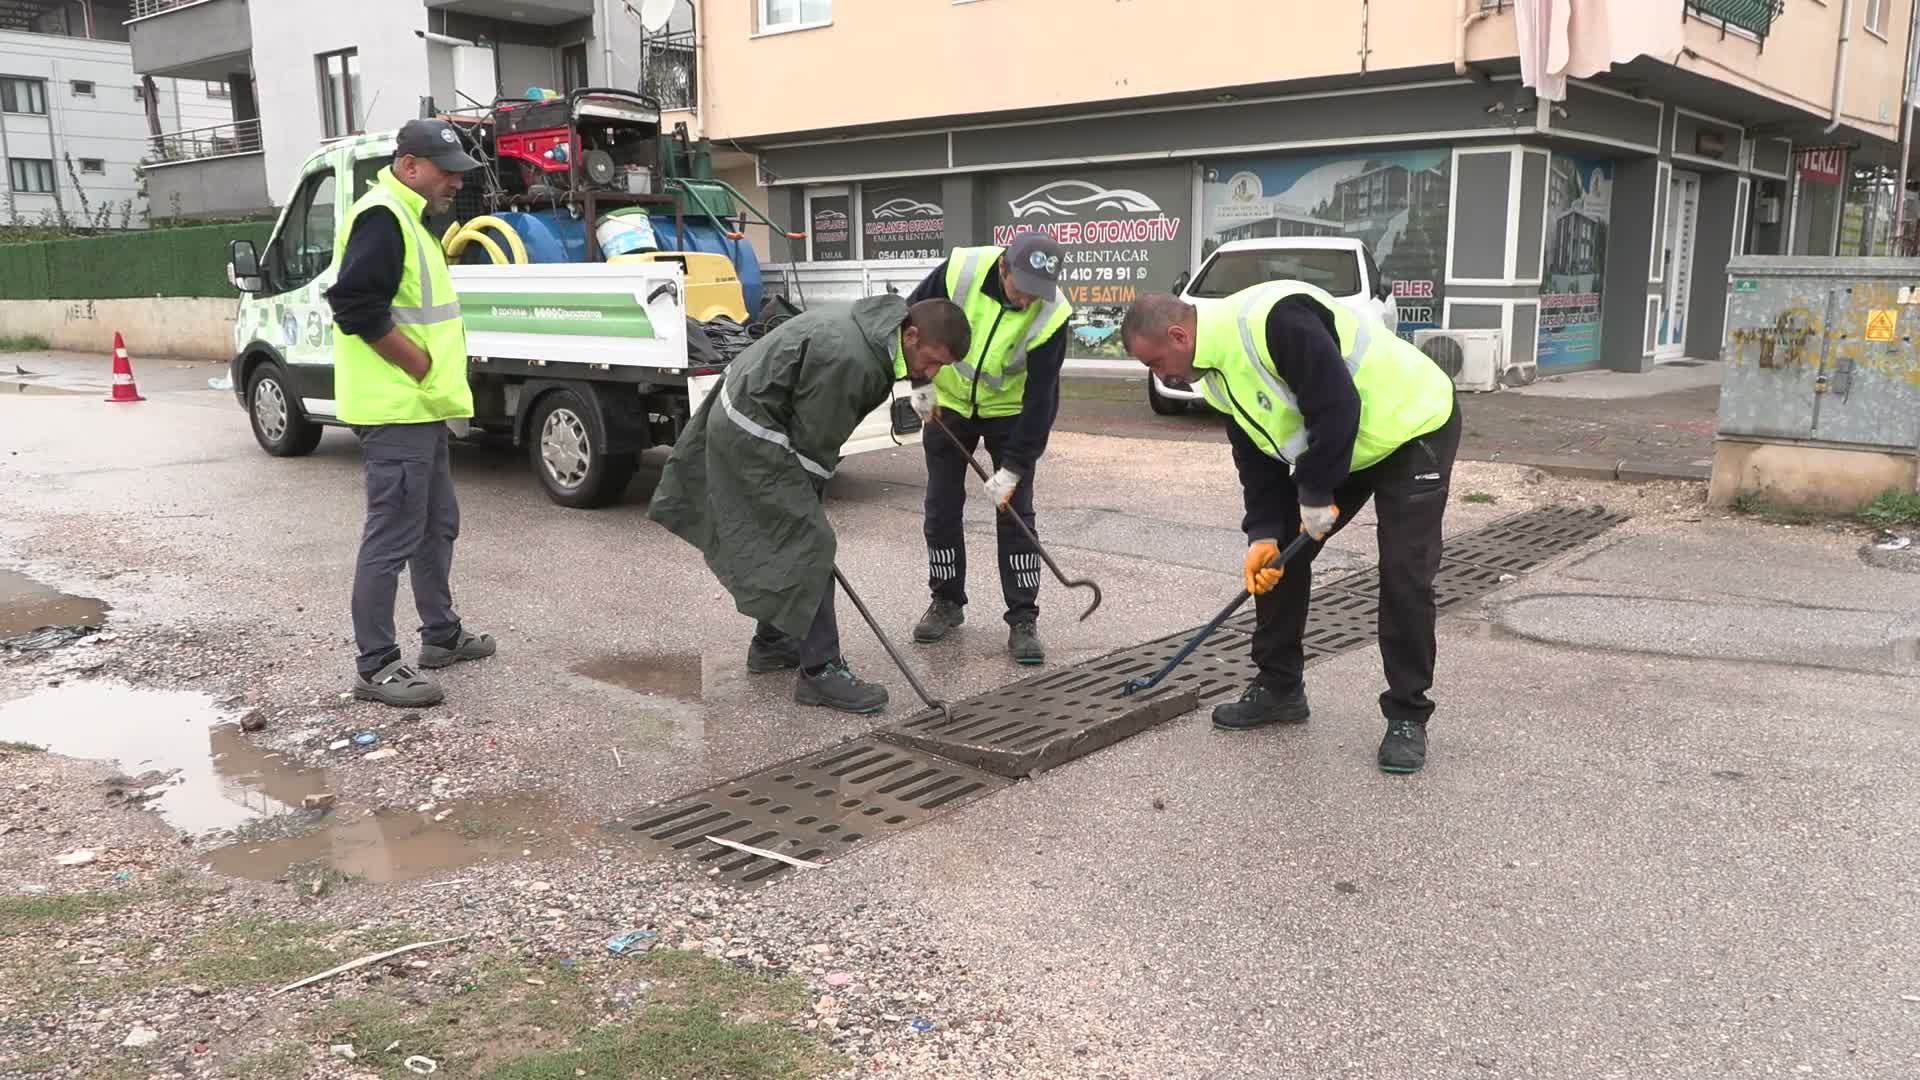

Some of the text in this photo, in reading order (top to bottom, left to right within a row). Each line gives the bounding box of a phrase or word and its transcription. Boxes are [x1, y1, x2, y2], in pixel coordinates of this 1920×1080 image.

[1084, 212, 1180, 243] OTOMOTİV
[1063, 250, 1149, 263] & RENTACAR
[1070, 267, 1092, 281] 410
[1096, 267, 1113, 280] 78
[1116, 266, 1131, 280] 91
[1069, 286, 1089, 303] VE
